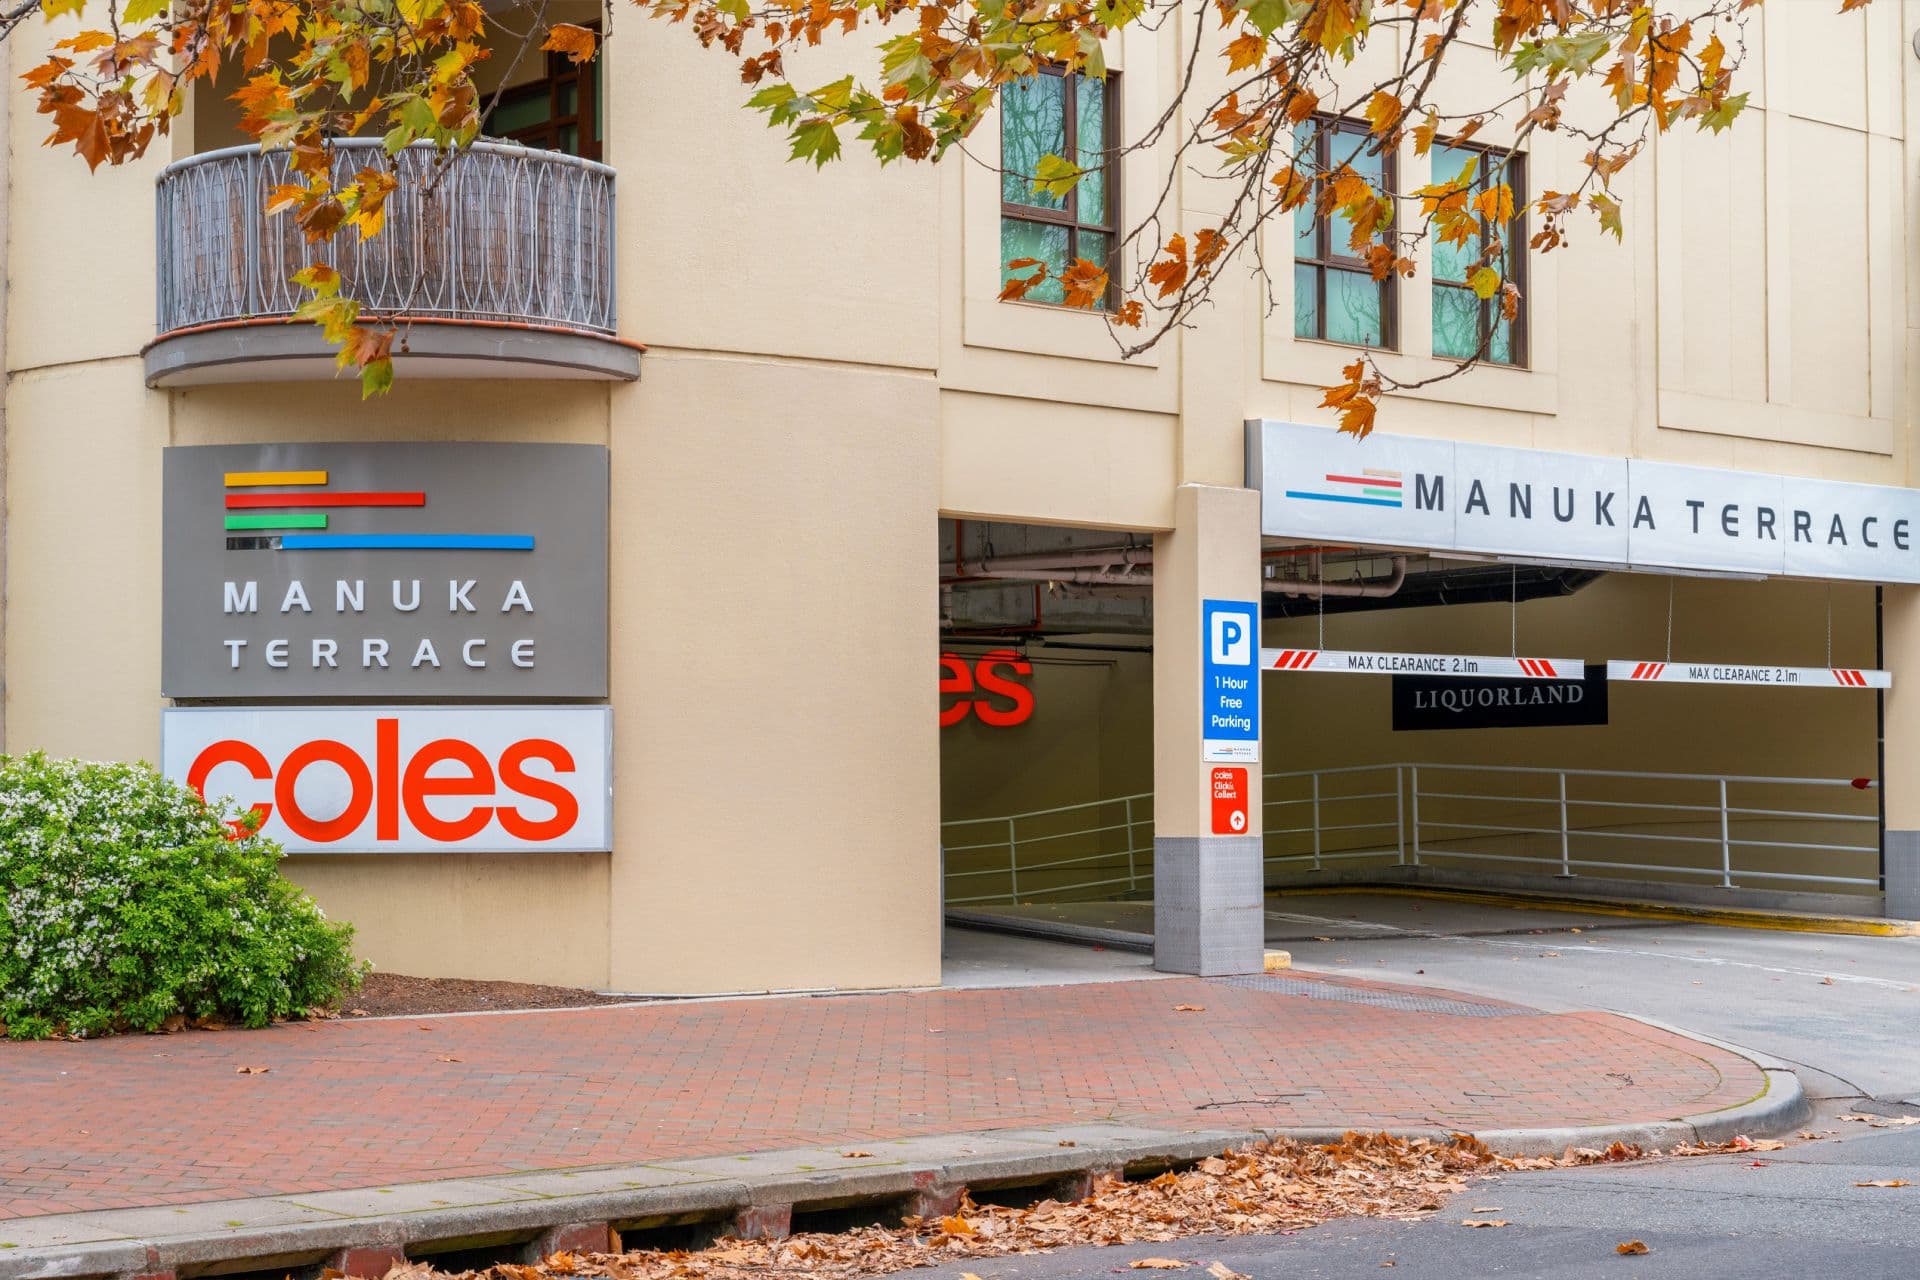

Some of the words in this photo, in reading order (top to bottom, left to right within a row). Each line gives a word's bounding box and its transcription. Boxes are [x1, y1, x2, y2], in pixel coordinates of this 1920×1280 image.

[1415, 473, 1656, 530] MANUKA
[1686, 499, 1910, 550] TERRACE
[223, 579, 534, 614] MANUKA
[1222, 621, 1241, 655] P
[223, 638, 535, 669] TERRACE
[1348, 655, 1373, 670] MAX
[1377, 656, 1446, 672] CLEARANCE
[1452, 658, 1478, 673] 2.1m
[1215, 676, 1220, 689] 1
[1222, 676, 1248, 690] Hour
[1689, 666, 1711, 680] MAX
[1713, 667, 1771, 682] CLEARANCE
[1775, 668, 1798, 683] 2.1m
[1220, 695, 1242, 708] Free
[1415, 684, 1585, 712] LIQUORLAND
[1212, 715, 1250, 731] Parking
[186, 718, 580, 843] coles
[1214, 790, 1237, 799] Collect
